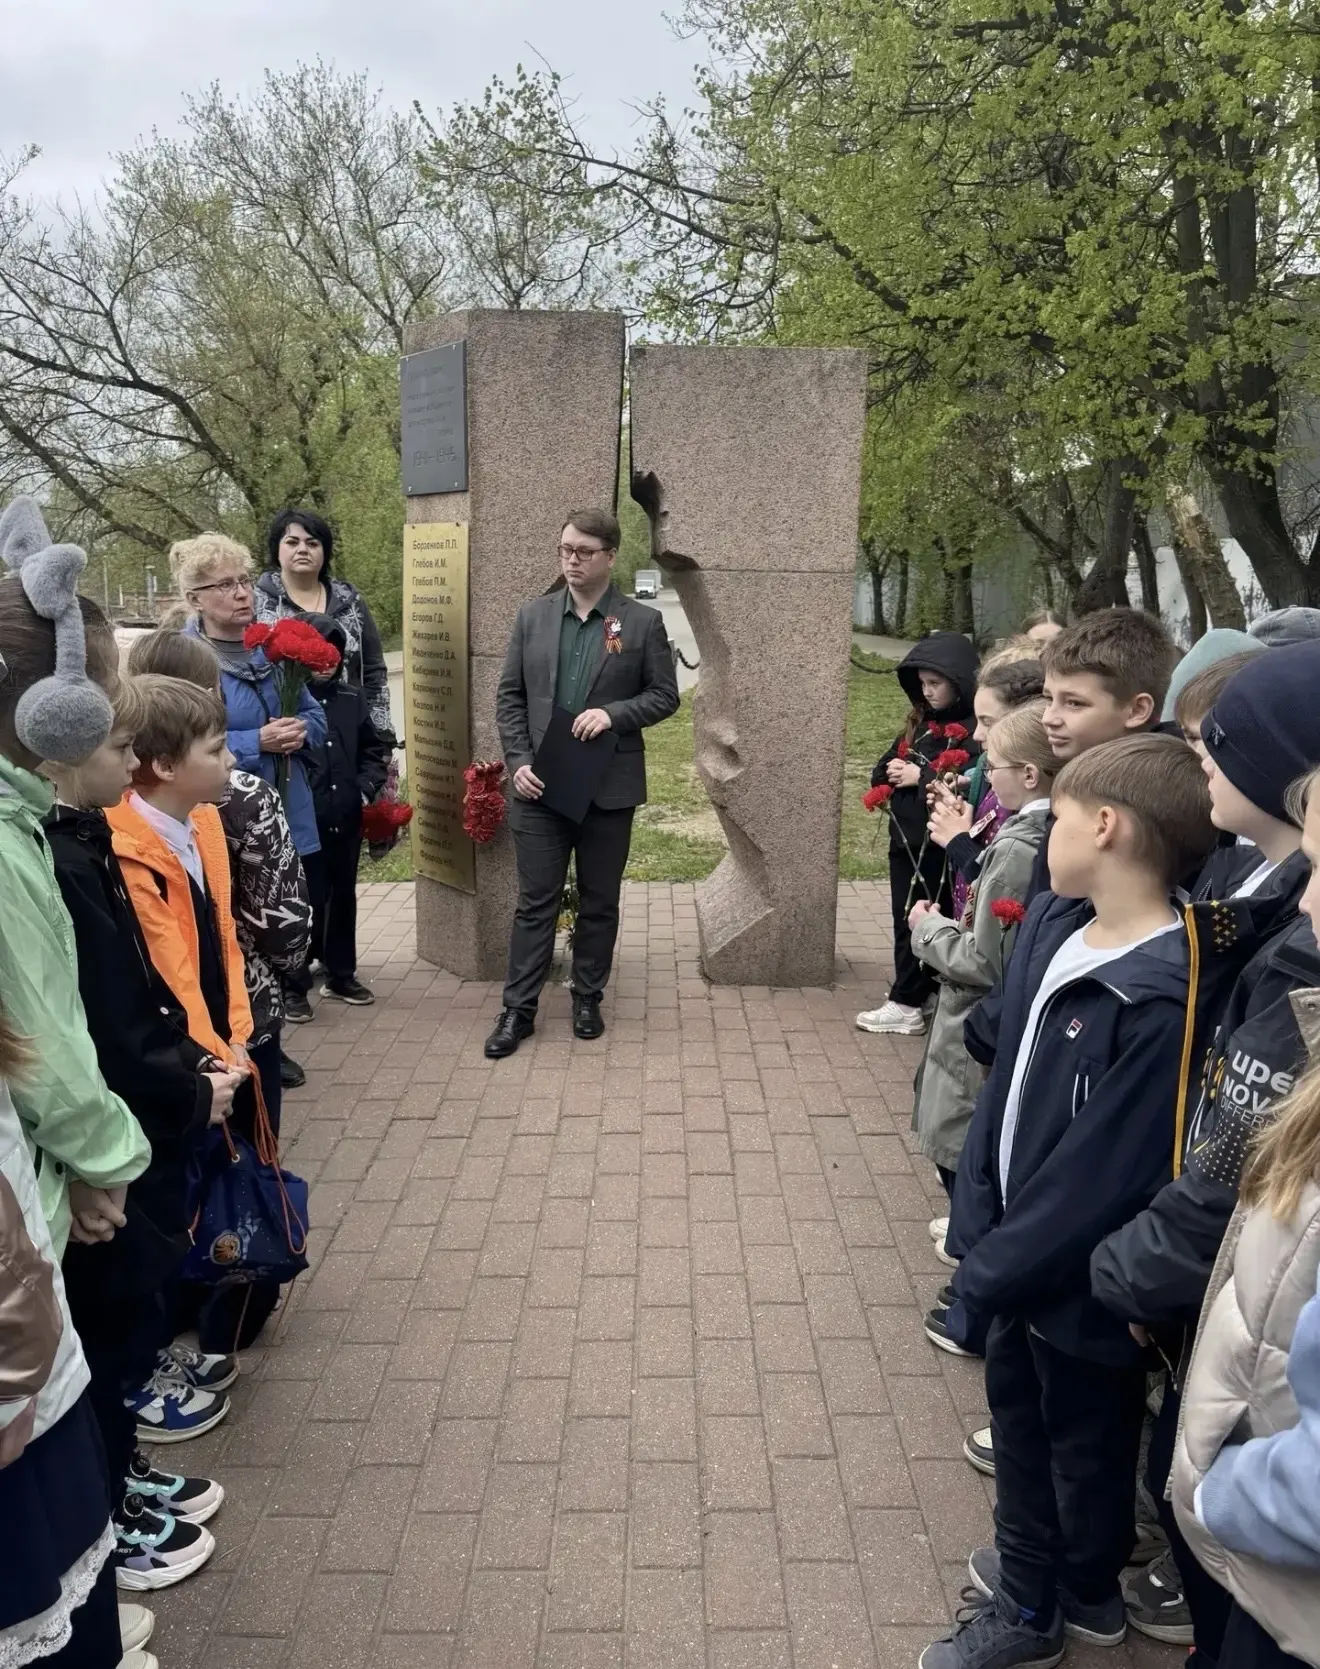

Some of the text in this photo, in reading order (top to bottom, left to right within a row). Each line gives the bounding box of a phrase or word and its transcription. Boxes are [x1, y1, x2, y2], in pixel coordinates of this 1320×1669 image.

[412, 558, 433, 568] Глебов
[412, 576, 433, 587] Глебов
[412, 612, 433, 624] Егоров
